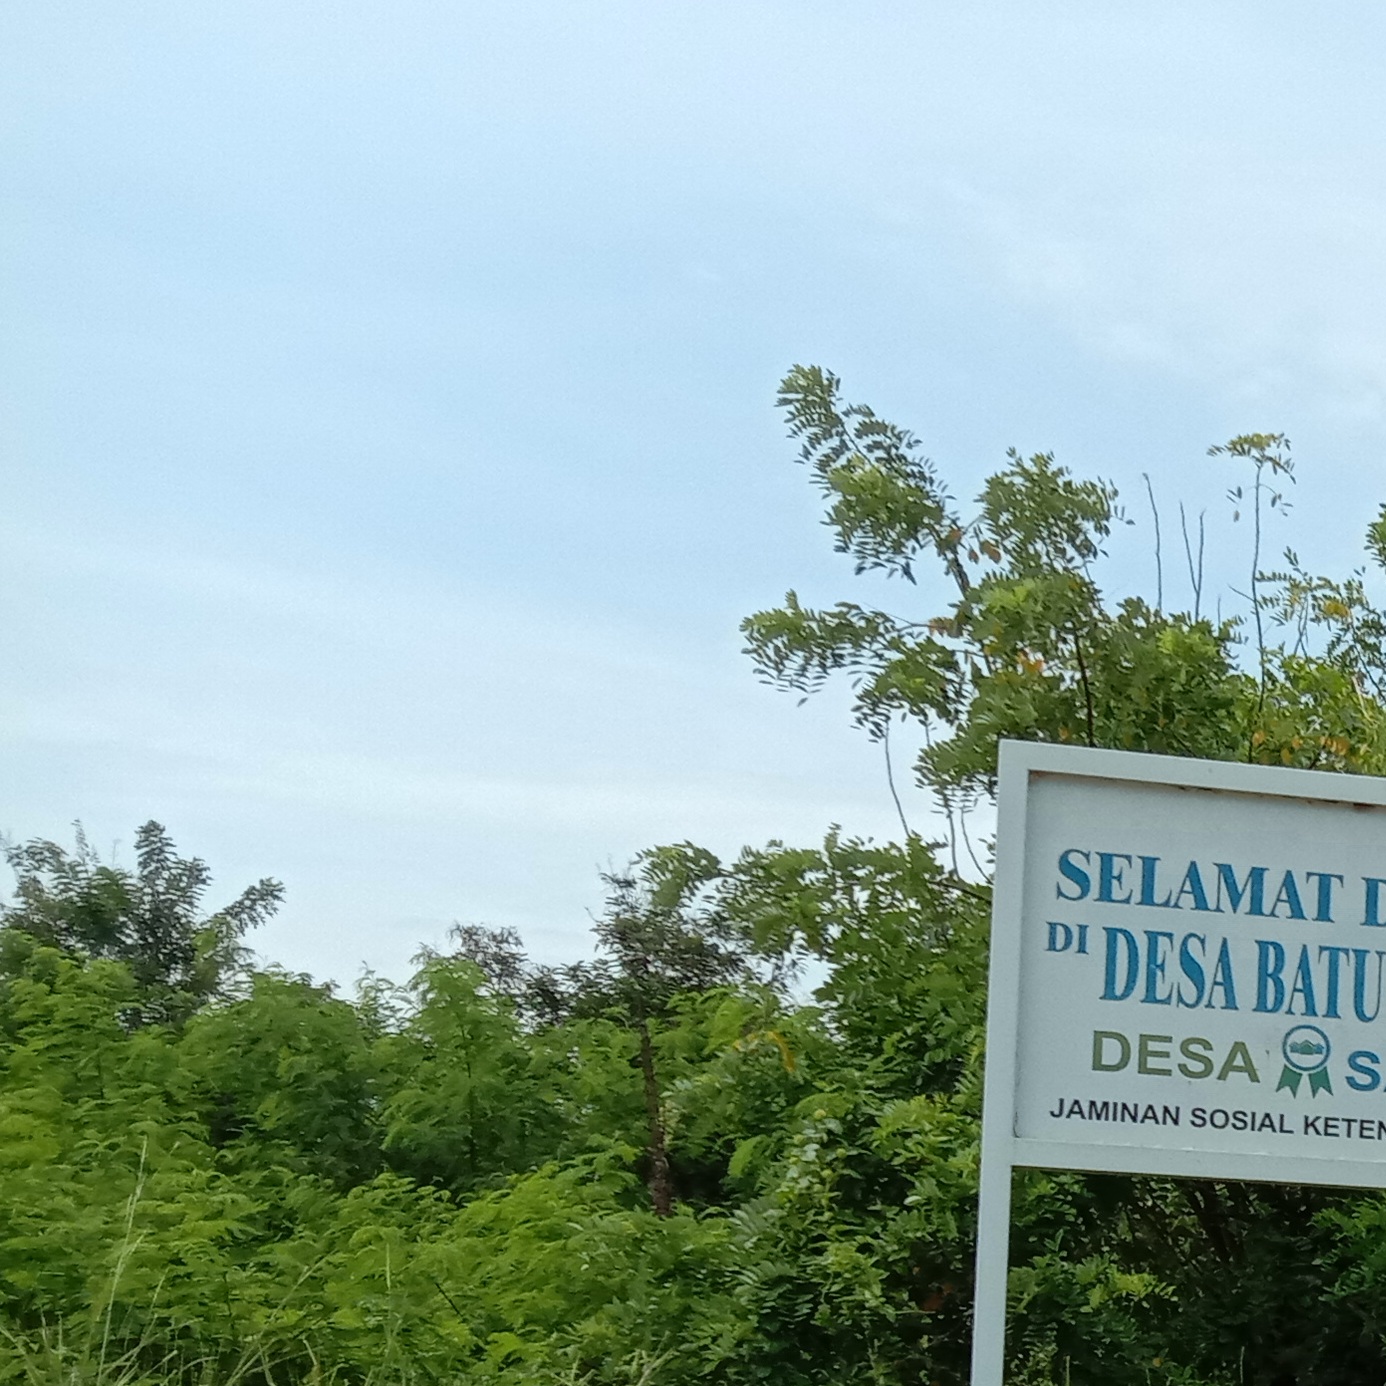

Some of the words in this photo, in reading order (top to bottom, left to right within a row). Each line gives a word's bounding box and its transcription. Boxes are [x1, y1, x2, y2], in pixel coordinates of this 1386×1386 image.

[1055, 848, 1344, 923] SELAMAT
[1046, 920, 1089, 955] DI
[1100, 926, 1239, 1012] DESA
[1252, 939, 1386, 1024] BATU
[1092, 1030, 1260, 1084] DESA
[1049, 1097, 1181, 1128] JAMINAN
[1190, 1106, 1294, 1136] SOSIAL
